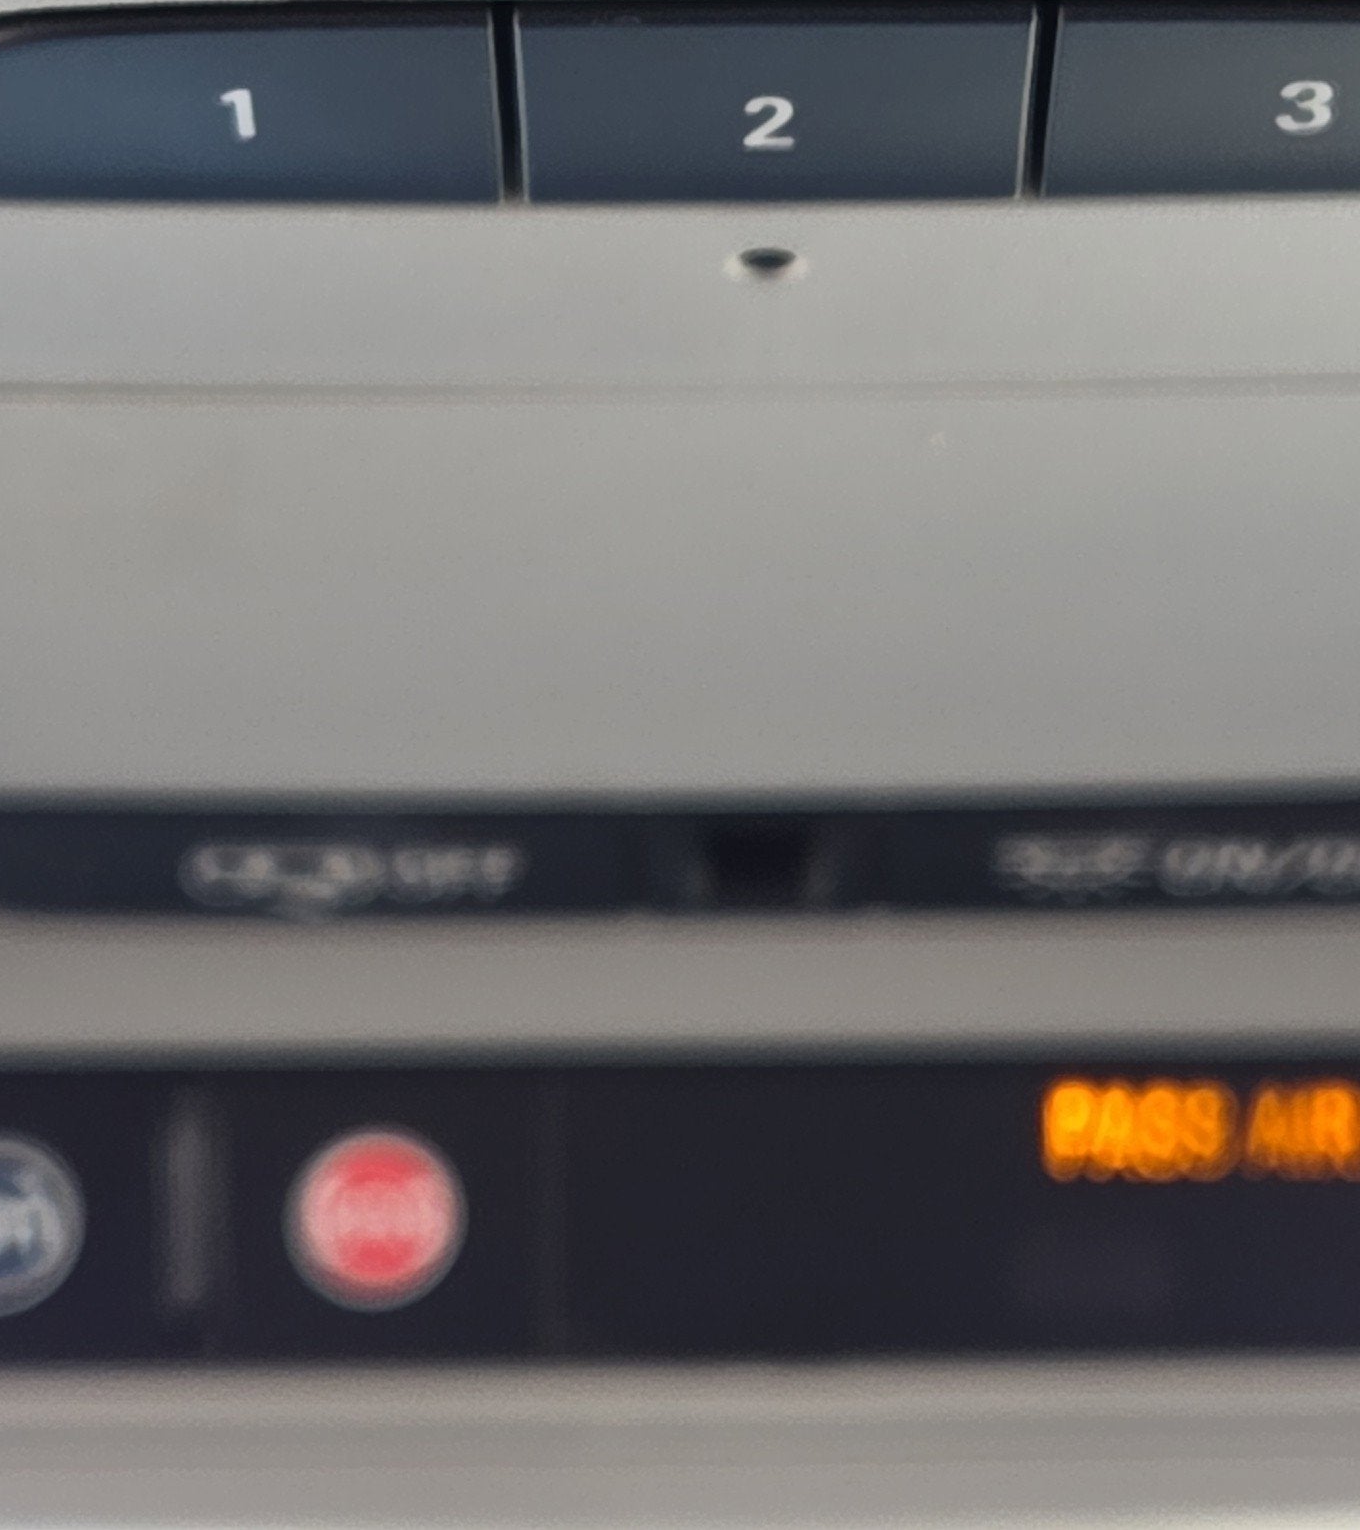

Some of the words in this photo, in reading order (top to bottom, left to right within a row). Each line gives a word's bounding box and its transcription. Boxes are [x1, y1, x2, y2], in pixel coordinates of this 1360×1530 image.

[221, 88, 256, 139] 1
[743, 96, 794, 148] 2
[1276, 80, 1334, 132] 3
[1042, 1078, 1234, 1180] PASS
